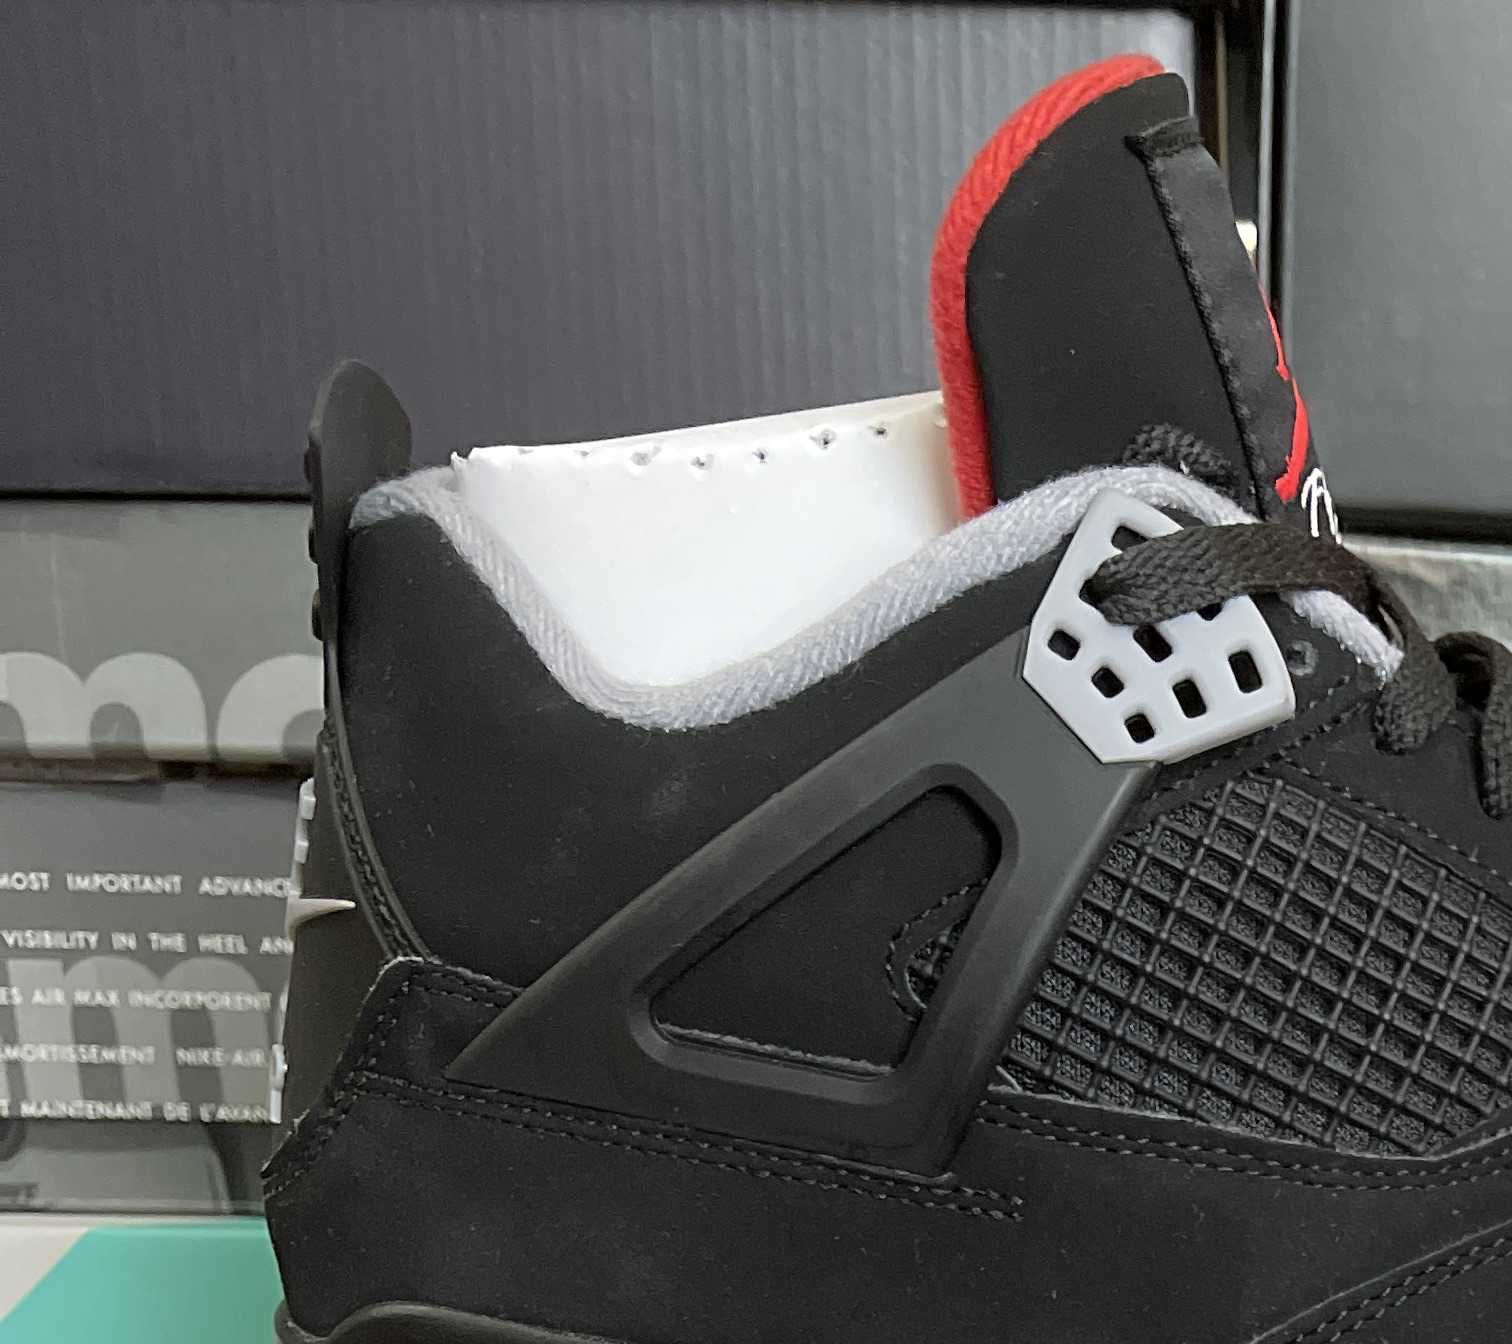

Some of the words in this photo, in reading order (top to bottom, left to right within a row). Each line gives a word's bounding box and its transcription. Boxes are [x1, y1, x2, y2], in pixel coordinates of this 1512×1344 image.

[66, 872, 183, 894] IMPORTANT
[198, 875, 296, 899] ADVANC
[1, 929, 100, 950] VISIBILITY
[111, 931, 138, 951] IN
[148, 932, 188, 953] THE
[197, 933, 249, 955] HEEL
[31, 987, 66, 1008] AIR
[73, 988, 121, 1010] MAX
[127, 990, 273, 1012] INCORPORENT
[20, 1099, 154, 1121] MAINTENANT
[162, 1100, 192, 1122] DE
